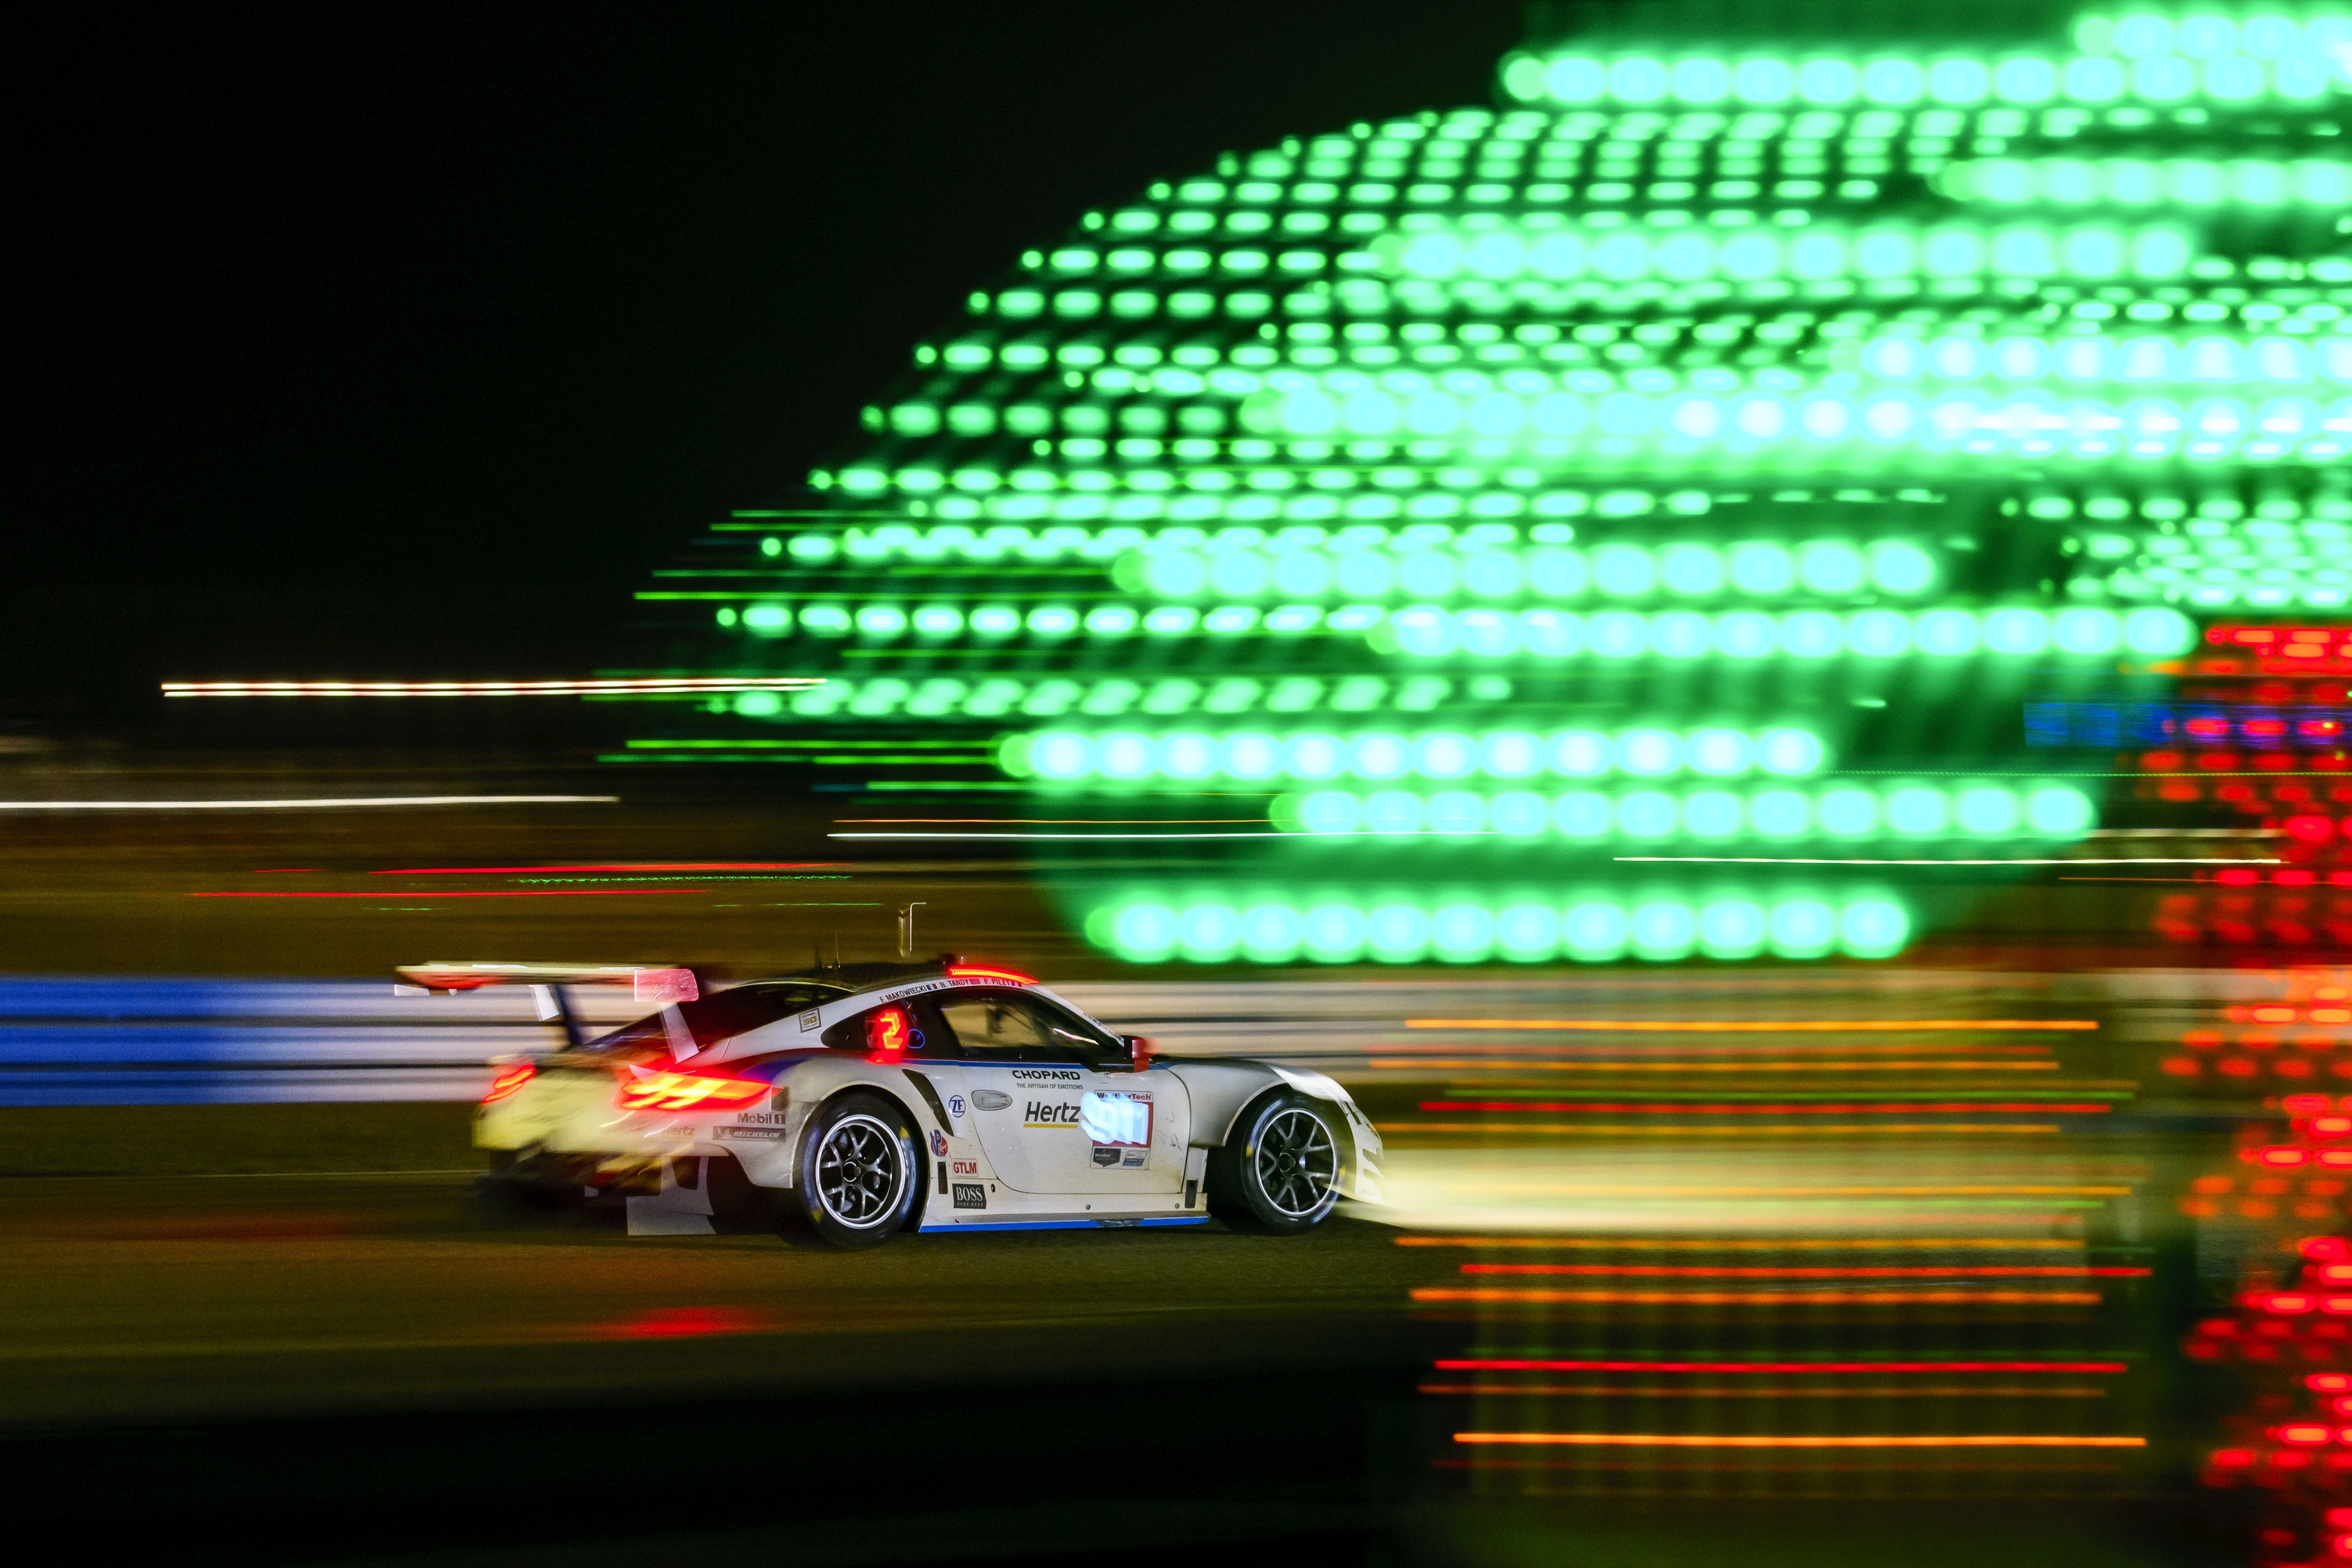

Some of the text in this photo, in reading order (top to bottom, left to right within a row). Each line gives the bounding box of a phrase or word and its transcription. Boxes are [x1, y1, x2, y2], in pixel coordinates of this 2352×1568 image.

[885, 985, 927, 1000] MAKOWIECKI
[880, 1012, 903, 1050] 2
[1012, 1070, 1081, 1080] CHOPARD
[737, 1112, 772, 1124] Mobil
[1024, 1101, 1081, 1123] Hertz
[733, 1130, 780, 1139] MICHELIN
[953, 1161, 977, 1174] GTLM
[956, 1186, 983, 1201] BOSS
